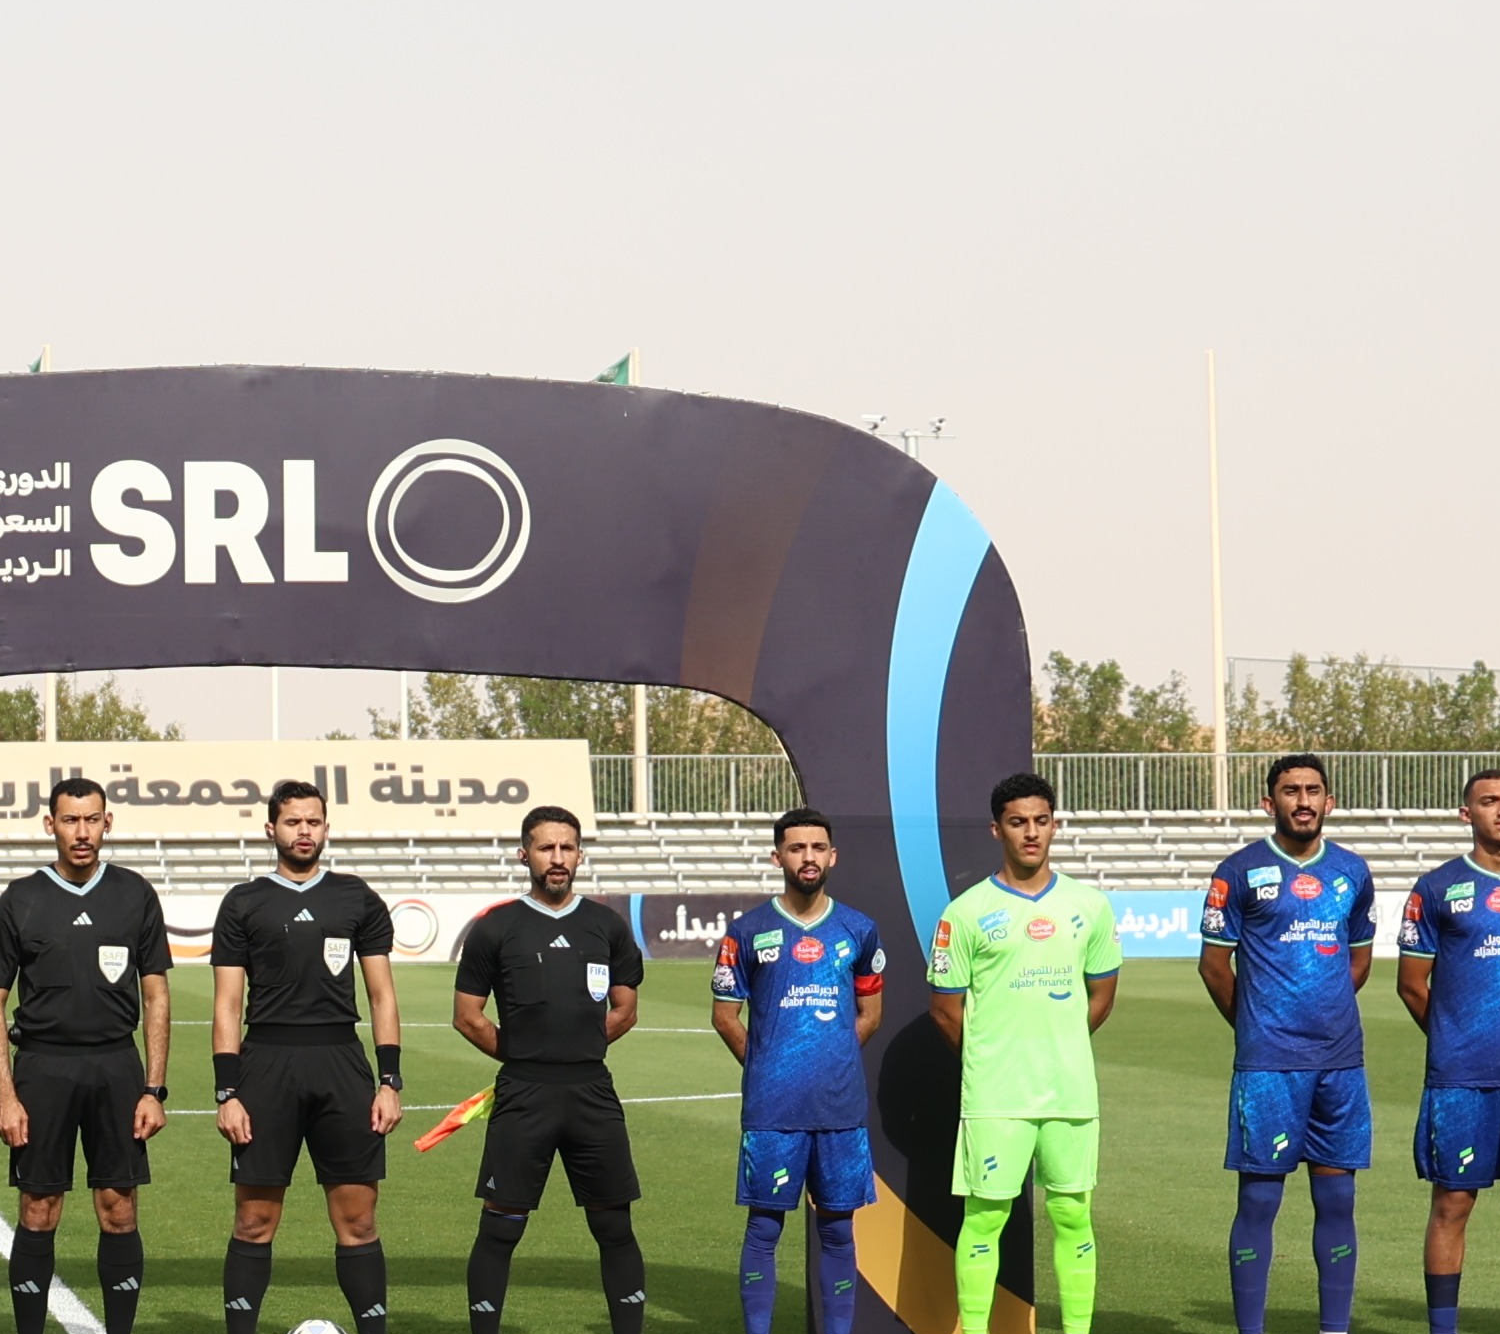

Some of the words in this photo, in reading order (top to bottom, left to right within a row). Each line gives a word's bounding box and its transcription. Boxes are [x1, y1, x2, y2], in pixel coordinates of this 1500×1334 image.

[90, 459, 349, 586] SRL
[369, 762, 529, 817] مدينة
[1474, 947, 1500, 958] aljabr
[590, 966, 607, 976] FIFA
[1009, 978, 1036, 989] aljabr
[1038, 978, 1073, 987] finance
